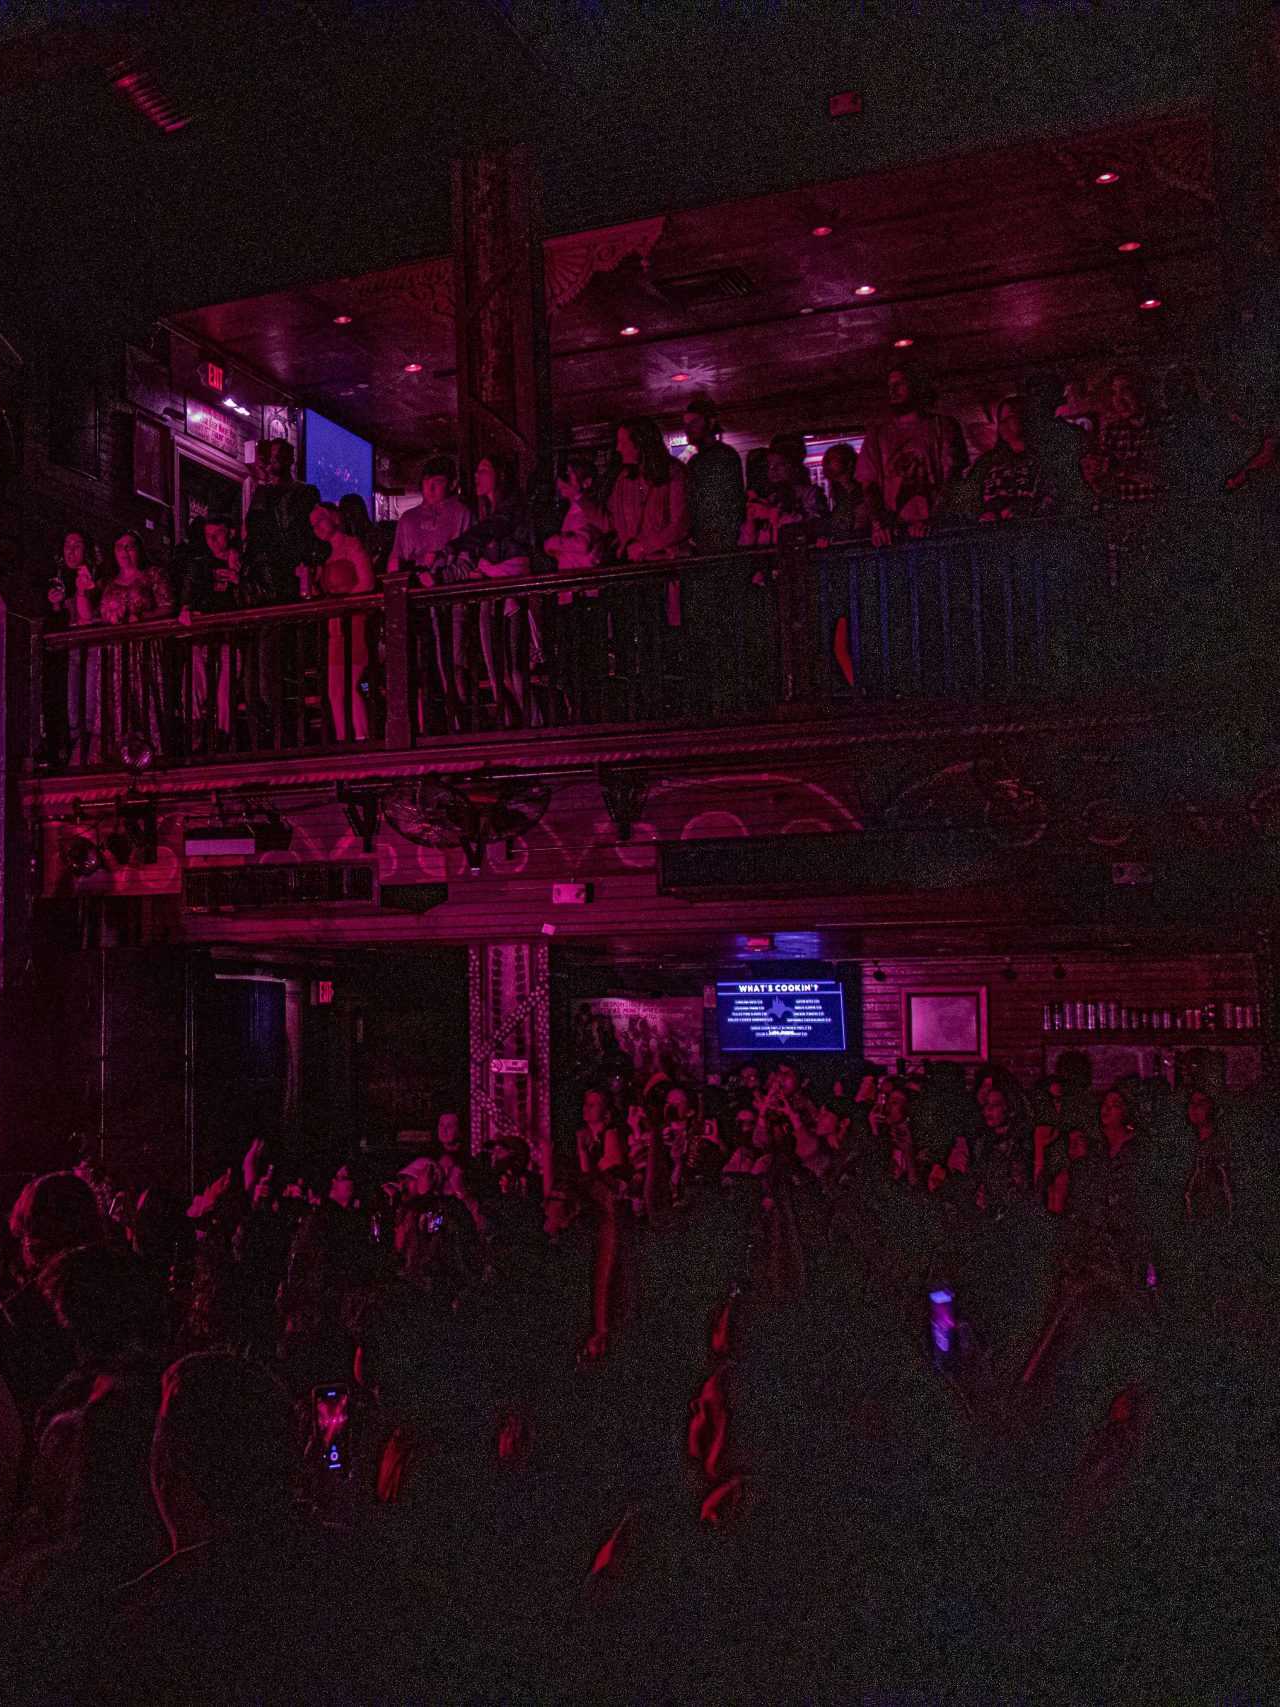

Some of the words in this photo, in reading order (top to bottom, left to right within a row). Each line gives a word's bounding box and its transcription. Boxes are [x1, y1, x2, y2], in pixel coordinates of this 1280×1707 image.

[207, 362, 224, 391] EXIT
[738, 984, 773, 993] WHAT'S
[775, 984, 819, 993] COOKIN'?
